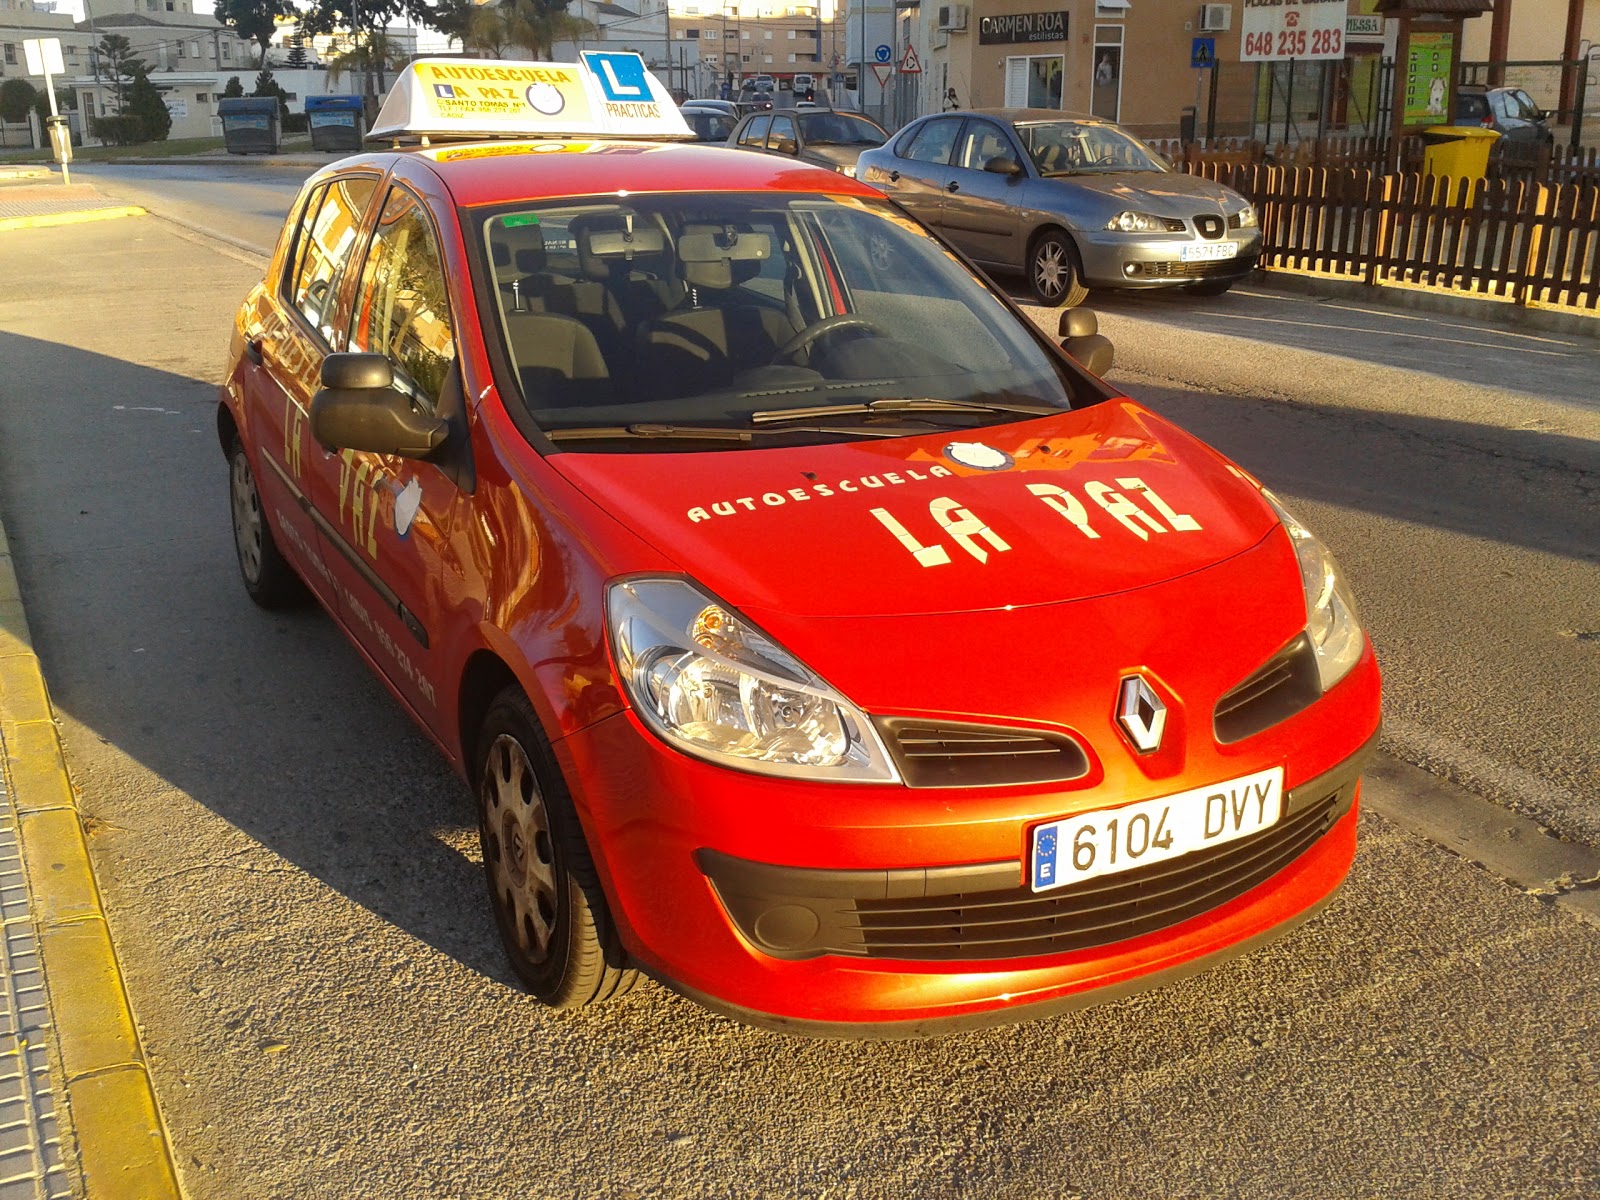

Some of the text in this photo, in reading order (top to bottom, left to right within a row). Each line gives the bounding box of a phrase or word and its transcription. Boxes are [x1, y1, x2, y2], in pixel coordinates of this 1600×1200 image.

[982, 13, 1064, 42] CARMEN ROA
[1029, 32, 1064, 41] estilistas
[1245, 28, 1342, 56] 648 235 283
[430, 66, 572, 83] AUTOESCUELA
[600, 59, 641, 95] L
[477, 87, 520, 99] PAZ
[445, 99, 477, 107] SANTO
[479, 100, 509, 108] TOMAS
[605, 103, 661, 118] PRACTICAS
[1216, 245, 1234, 257] FBC
[686, 465, 954, 523] AUTOESCUELA
[870, 476, 1204, 568] LA PAZ
[1072, 779, 1272, 871] 6104 DVY
[1040, 863, 1051, 878] E
